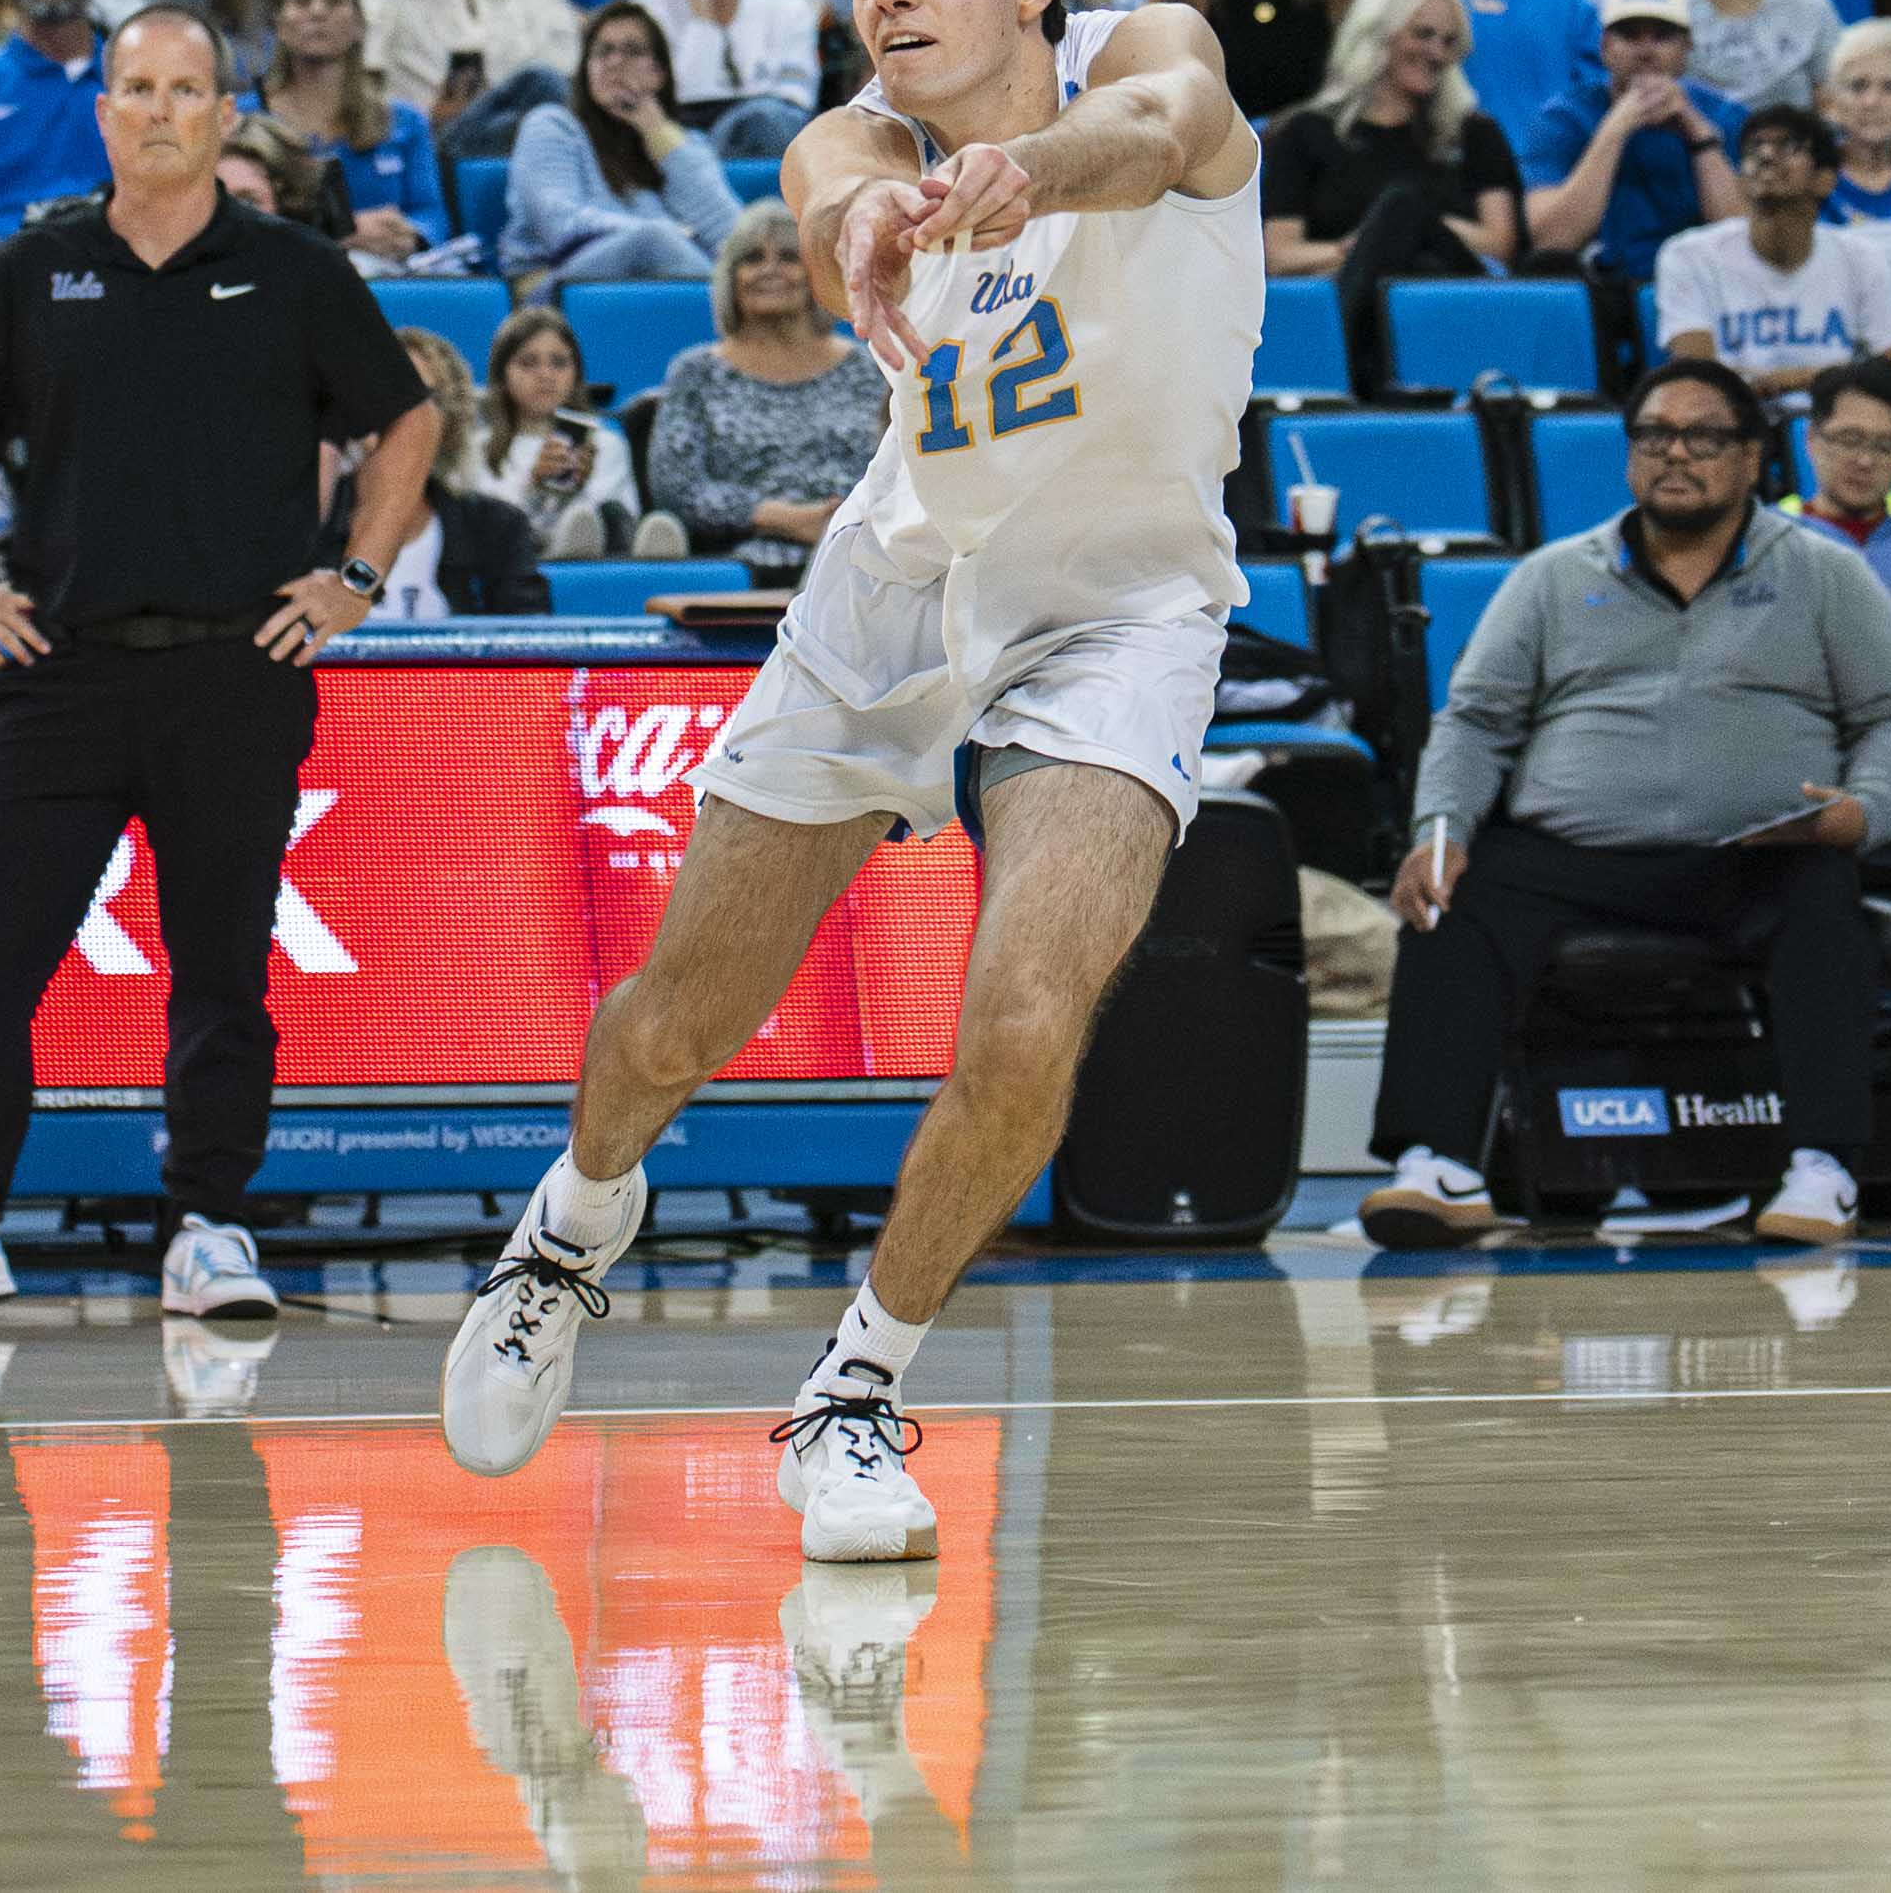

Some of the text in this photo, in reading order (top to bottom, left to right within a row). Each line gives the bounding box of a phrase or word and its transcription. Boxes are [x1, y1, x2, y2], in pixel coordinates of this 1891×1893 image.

[1717, 306, 1853, 354] UCLA
[915, 293, 1084, 457] 12
[1572, 1092, 1785, 1128] UCLA Healt
[340, 1123, 440, 1155] presented
[443, 1121, 471, 1154] by
